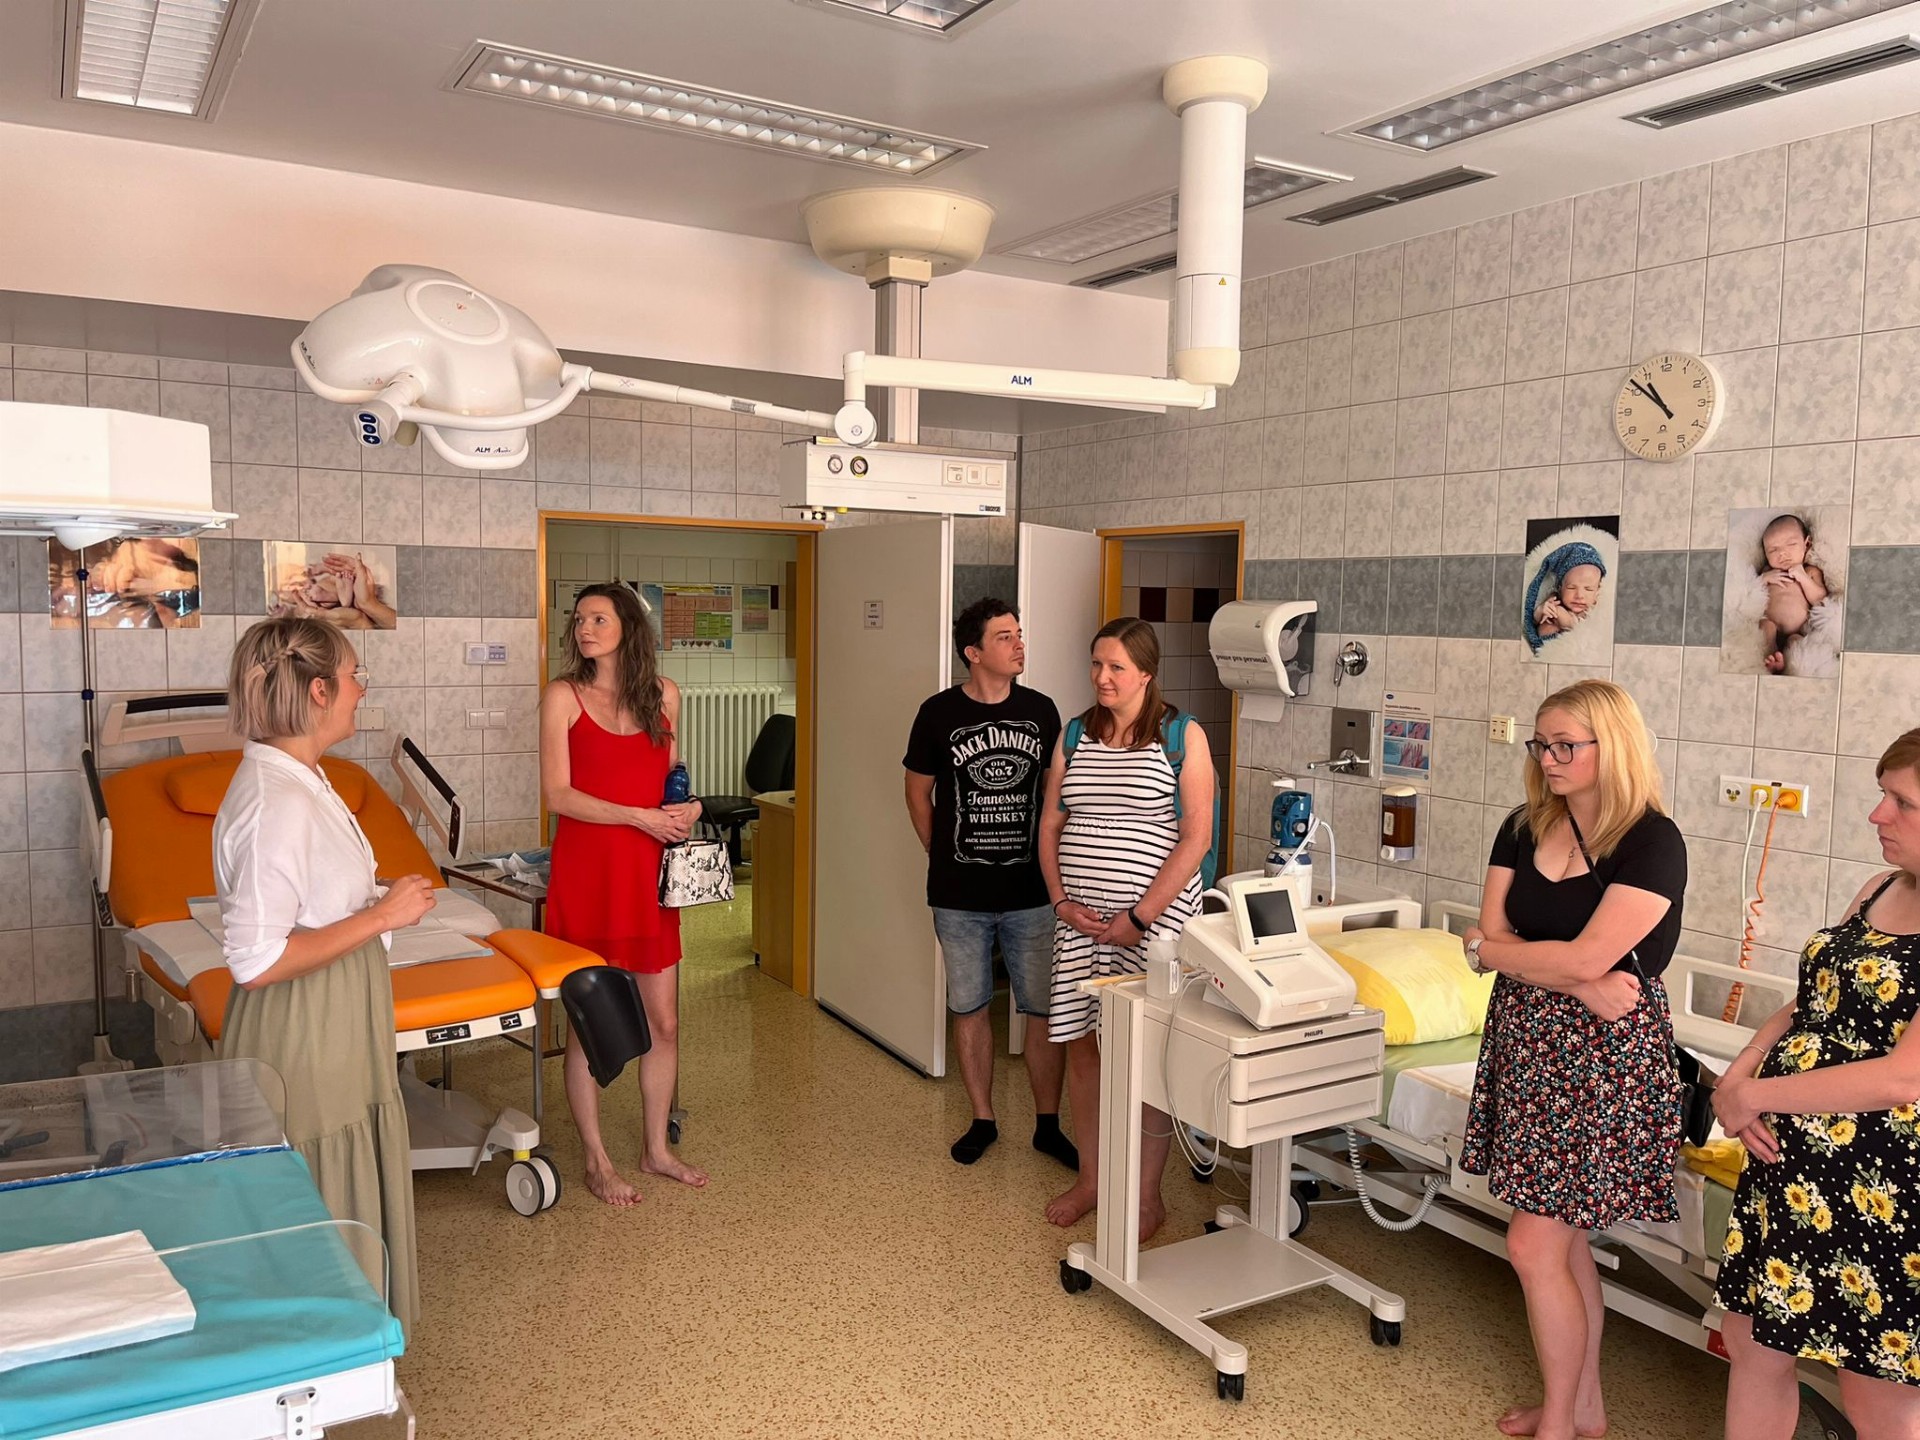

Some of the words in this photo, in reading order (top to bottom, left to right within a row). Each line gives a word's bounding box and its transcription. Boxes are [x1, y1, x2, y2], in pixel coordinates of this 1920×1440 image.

[1660, 364, 1672, 372] 12
[1011, 375, 1032, 385] ALM
[1693, 380, 1701, 388] 2
[1631, 388, 1642, 396] 10
[1697, 399, 1706, 407] 3
[1624, 408, 1632, 416] 9
[1691, 419, 1699, 427] 4
[1628, 426, 1636, 434] 8
[1677, 434, 1685, 443] 5
[1641, 439, 1649, 448] 7
[1658, 443, 1666, 451] 6
[951, 733, 989, 766] JACK
[985, 766, 1014, 777] No.7
[967, 791, 1028, 806] Tennessee
[969, 812, 1027, 823] WHISKEY
[1304, 1029, 1323, 1038] PHILIPS
